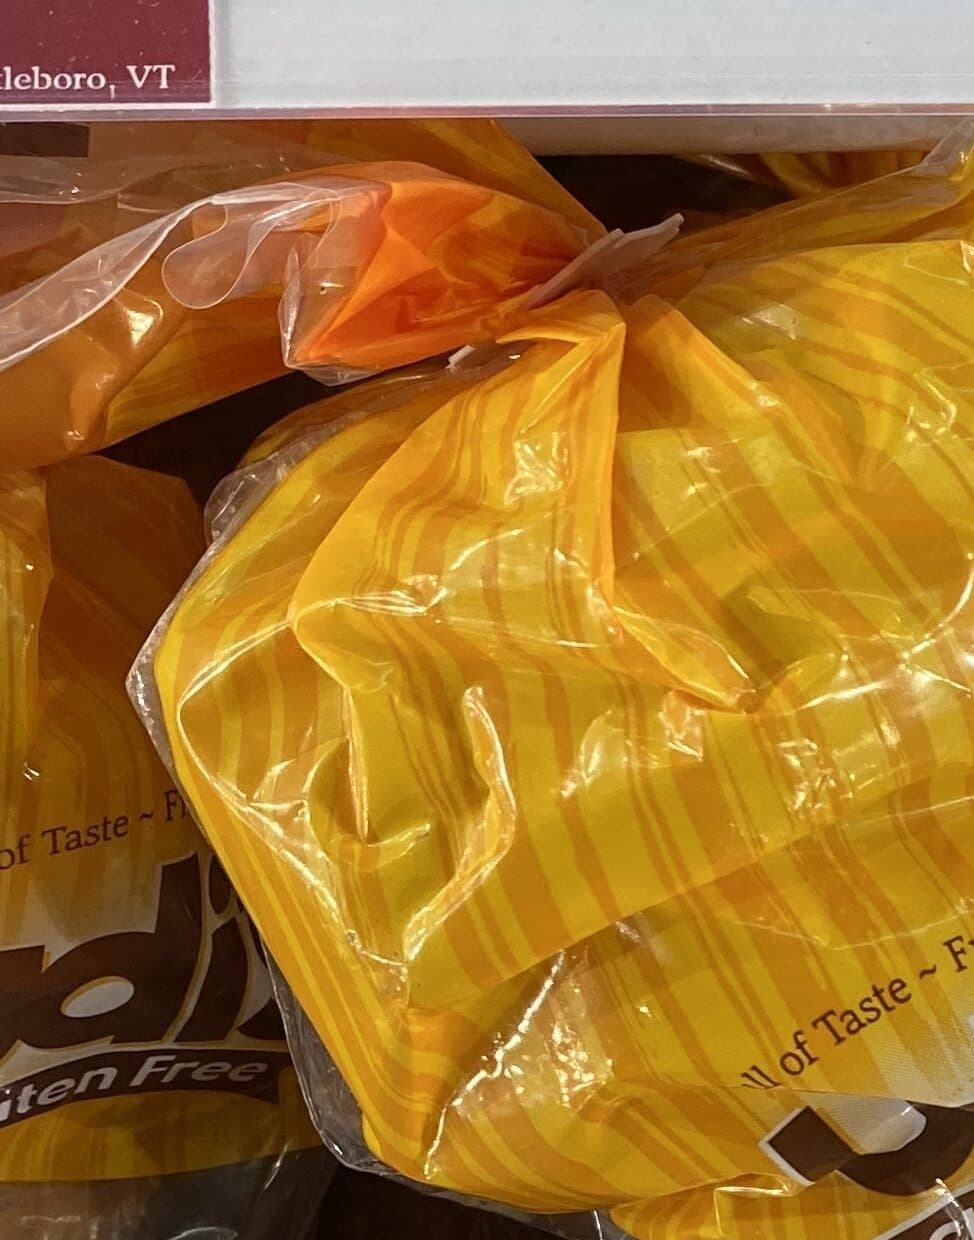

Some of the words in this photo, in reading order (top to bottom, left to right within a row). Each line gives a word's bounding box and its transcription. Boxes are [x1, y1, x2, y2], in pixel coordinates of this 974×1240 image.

[0, 66, 115, 100] leboro,
[126, 64, 176, 89] VT
[42, 815, 129, 857] Taste
[780, 1028, 819, 1077] of
[811, 976, 912, 1049] Taste
[130, 1054, 268, 1088] Free
